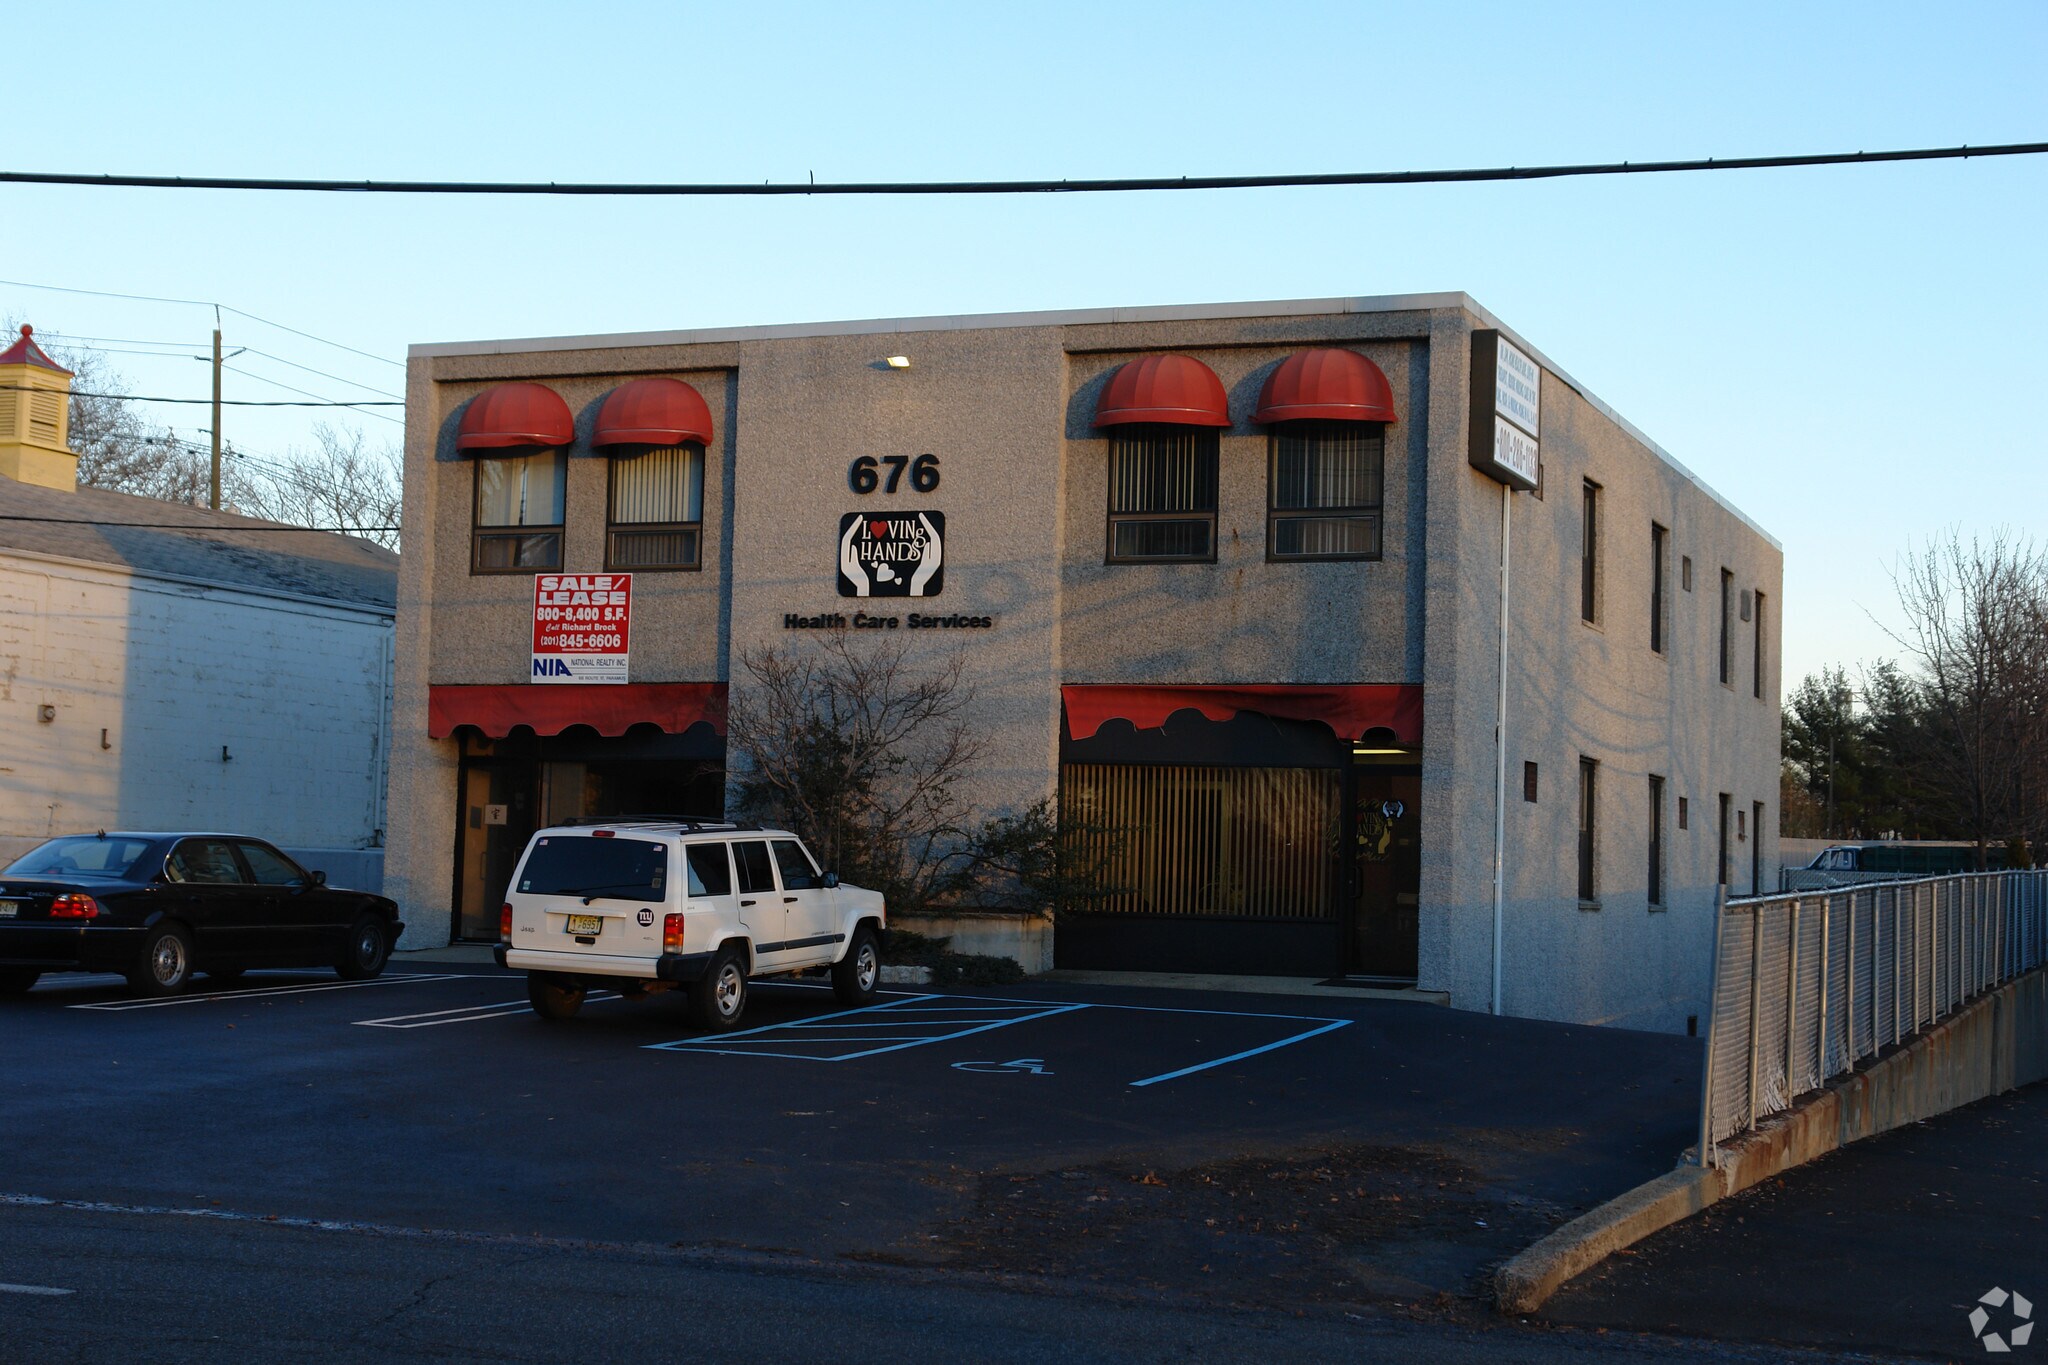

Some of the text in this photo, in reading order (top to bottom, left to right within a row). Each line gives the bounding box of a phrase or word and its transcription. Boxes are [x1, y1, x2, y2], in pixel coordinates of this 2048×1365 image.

[849, 454, 940, 494] 676
[860, 541, 922, 561] HANDS
[541, 577, 625, 591] SALE/
[539, 591, 626, 605] LEASE
[537, 607, 626, 622] 800-8,400 S.F.
[784, 613, 992, 629] Health Care Services
[545, 623, 616, 632] Call Richard Brock
[533, 658, 573, 676] NIA
[616, 659, 626, 667] INC.
